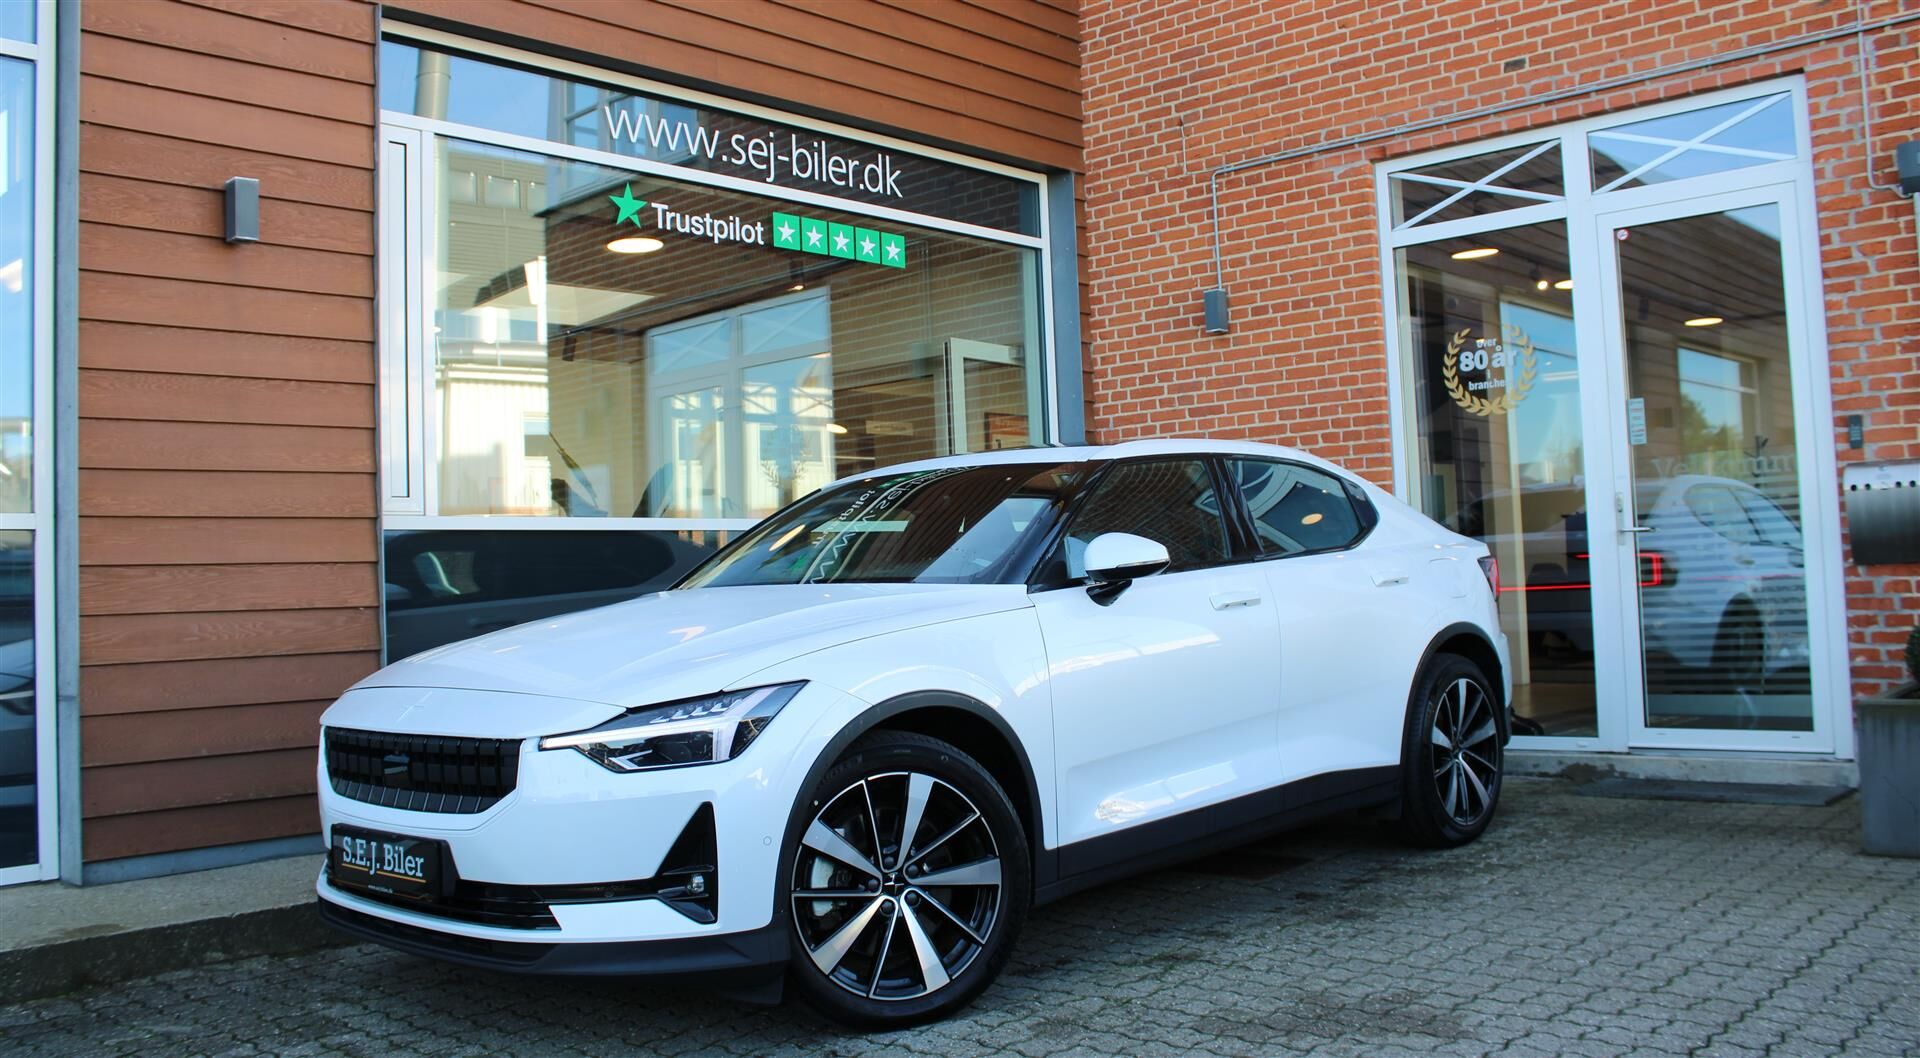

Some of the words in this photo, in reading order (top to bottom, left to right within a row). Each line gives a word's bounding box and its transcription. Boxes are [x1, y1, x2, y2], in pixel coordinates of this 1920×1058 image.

[604, 105, 903, 198] www.sej-biler.dk
[651, 202, 765, 245] Trustpilot
[1459, 350, 1488, 372] 80
[1491, 345, 1517, 369] år
[343, 836, 380, 875] S.E.J.
[383, 842, 424, 877] Biler
